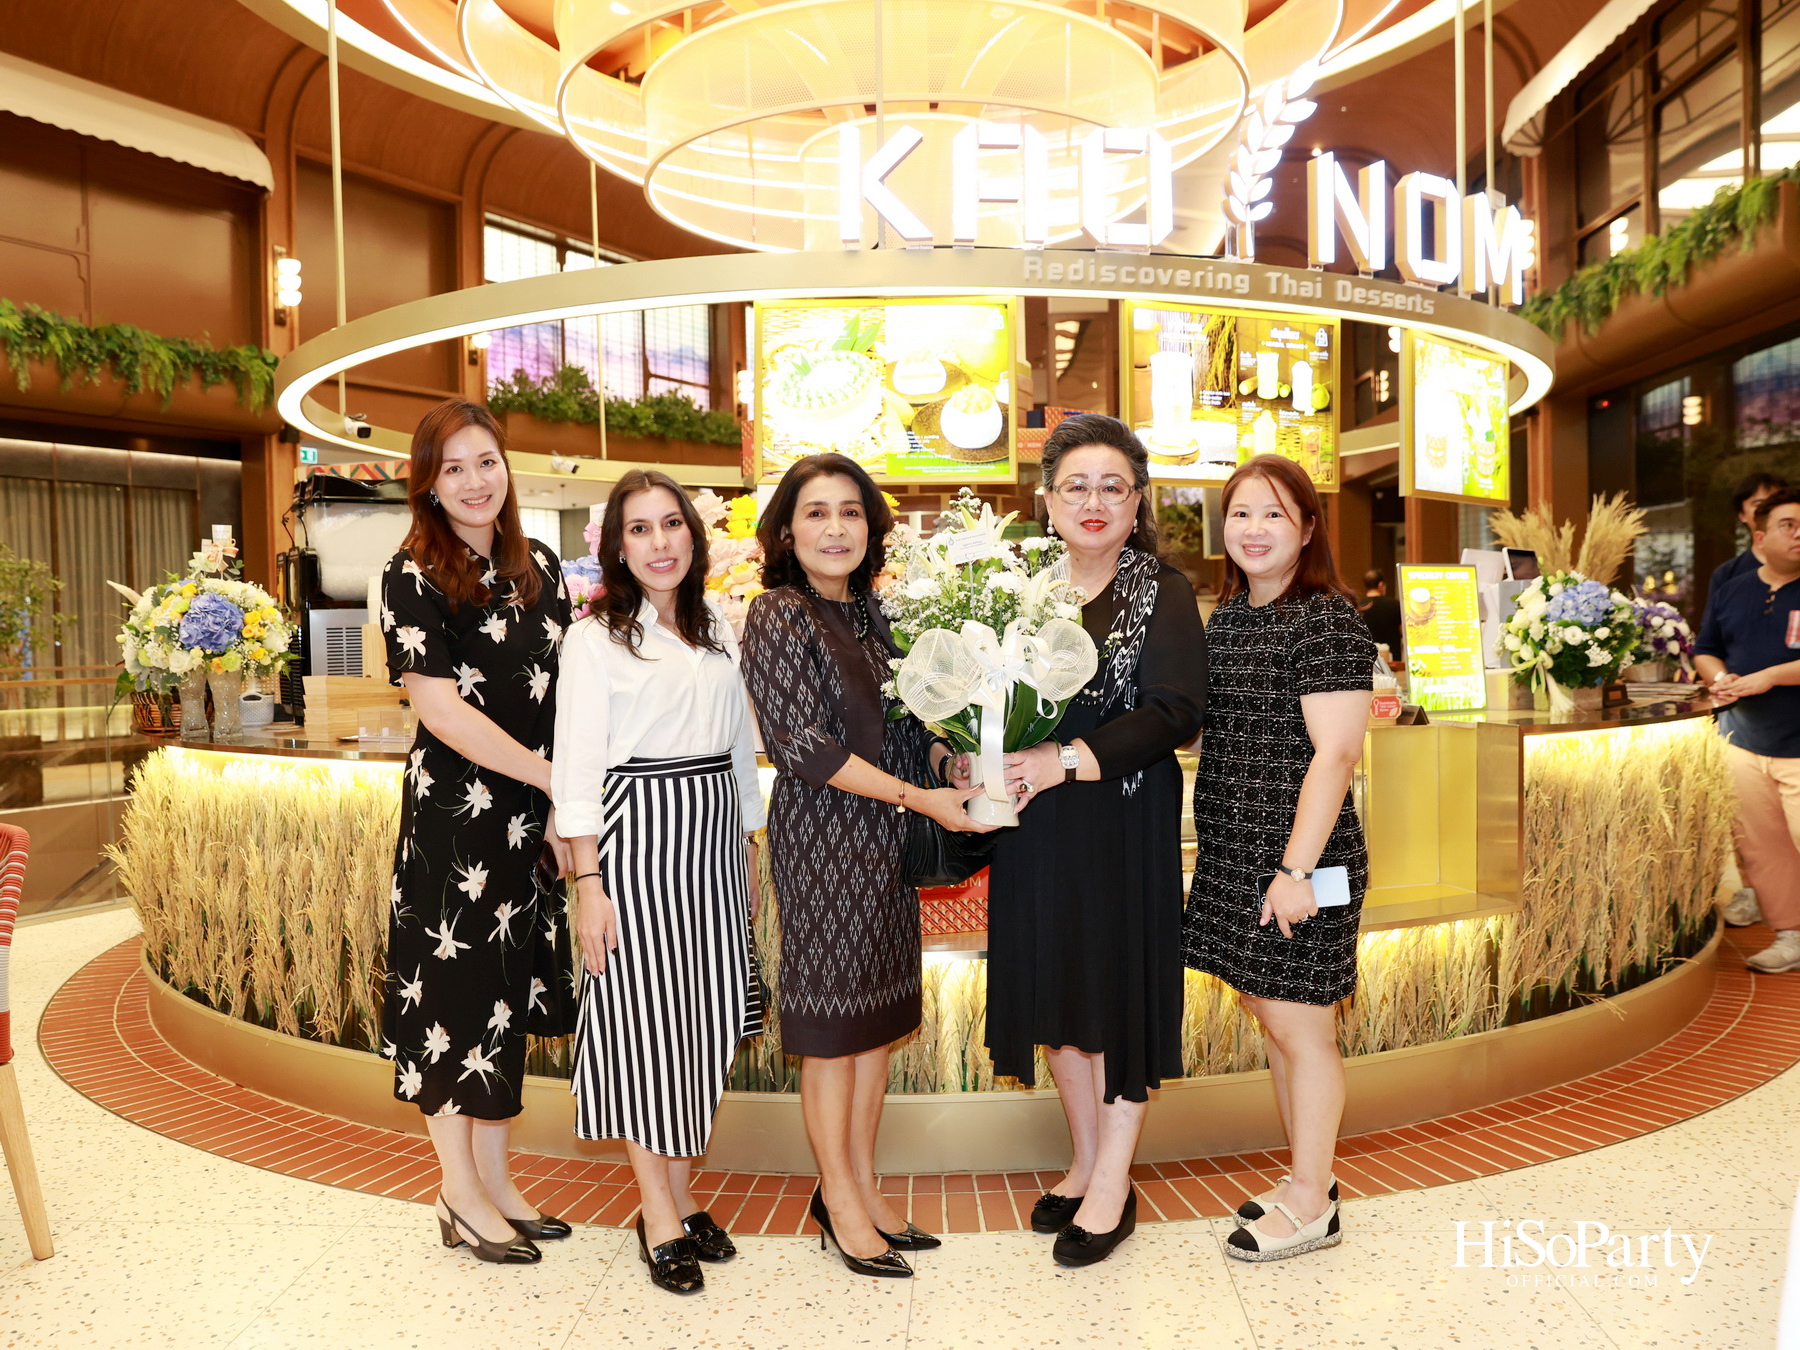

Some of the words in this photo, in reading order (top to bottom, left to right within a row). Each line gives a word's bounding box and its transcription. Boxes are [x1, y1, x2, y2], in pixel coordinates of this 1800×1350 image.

[1306, 151, 1523, 306] NOM
[1023, 256, 1250, 294] Rediscovering
[1265, 271, 1322, 299] Thai
[1336, 279, 1435, 315] Desserts
